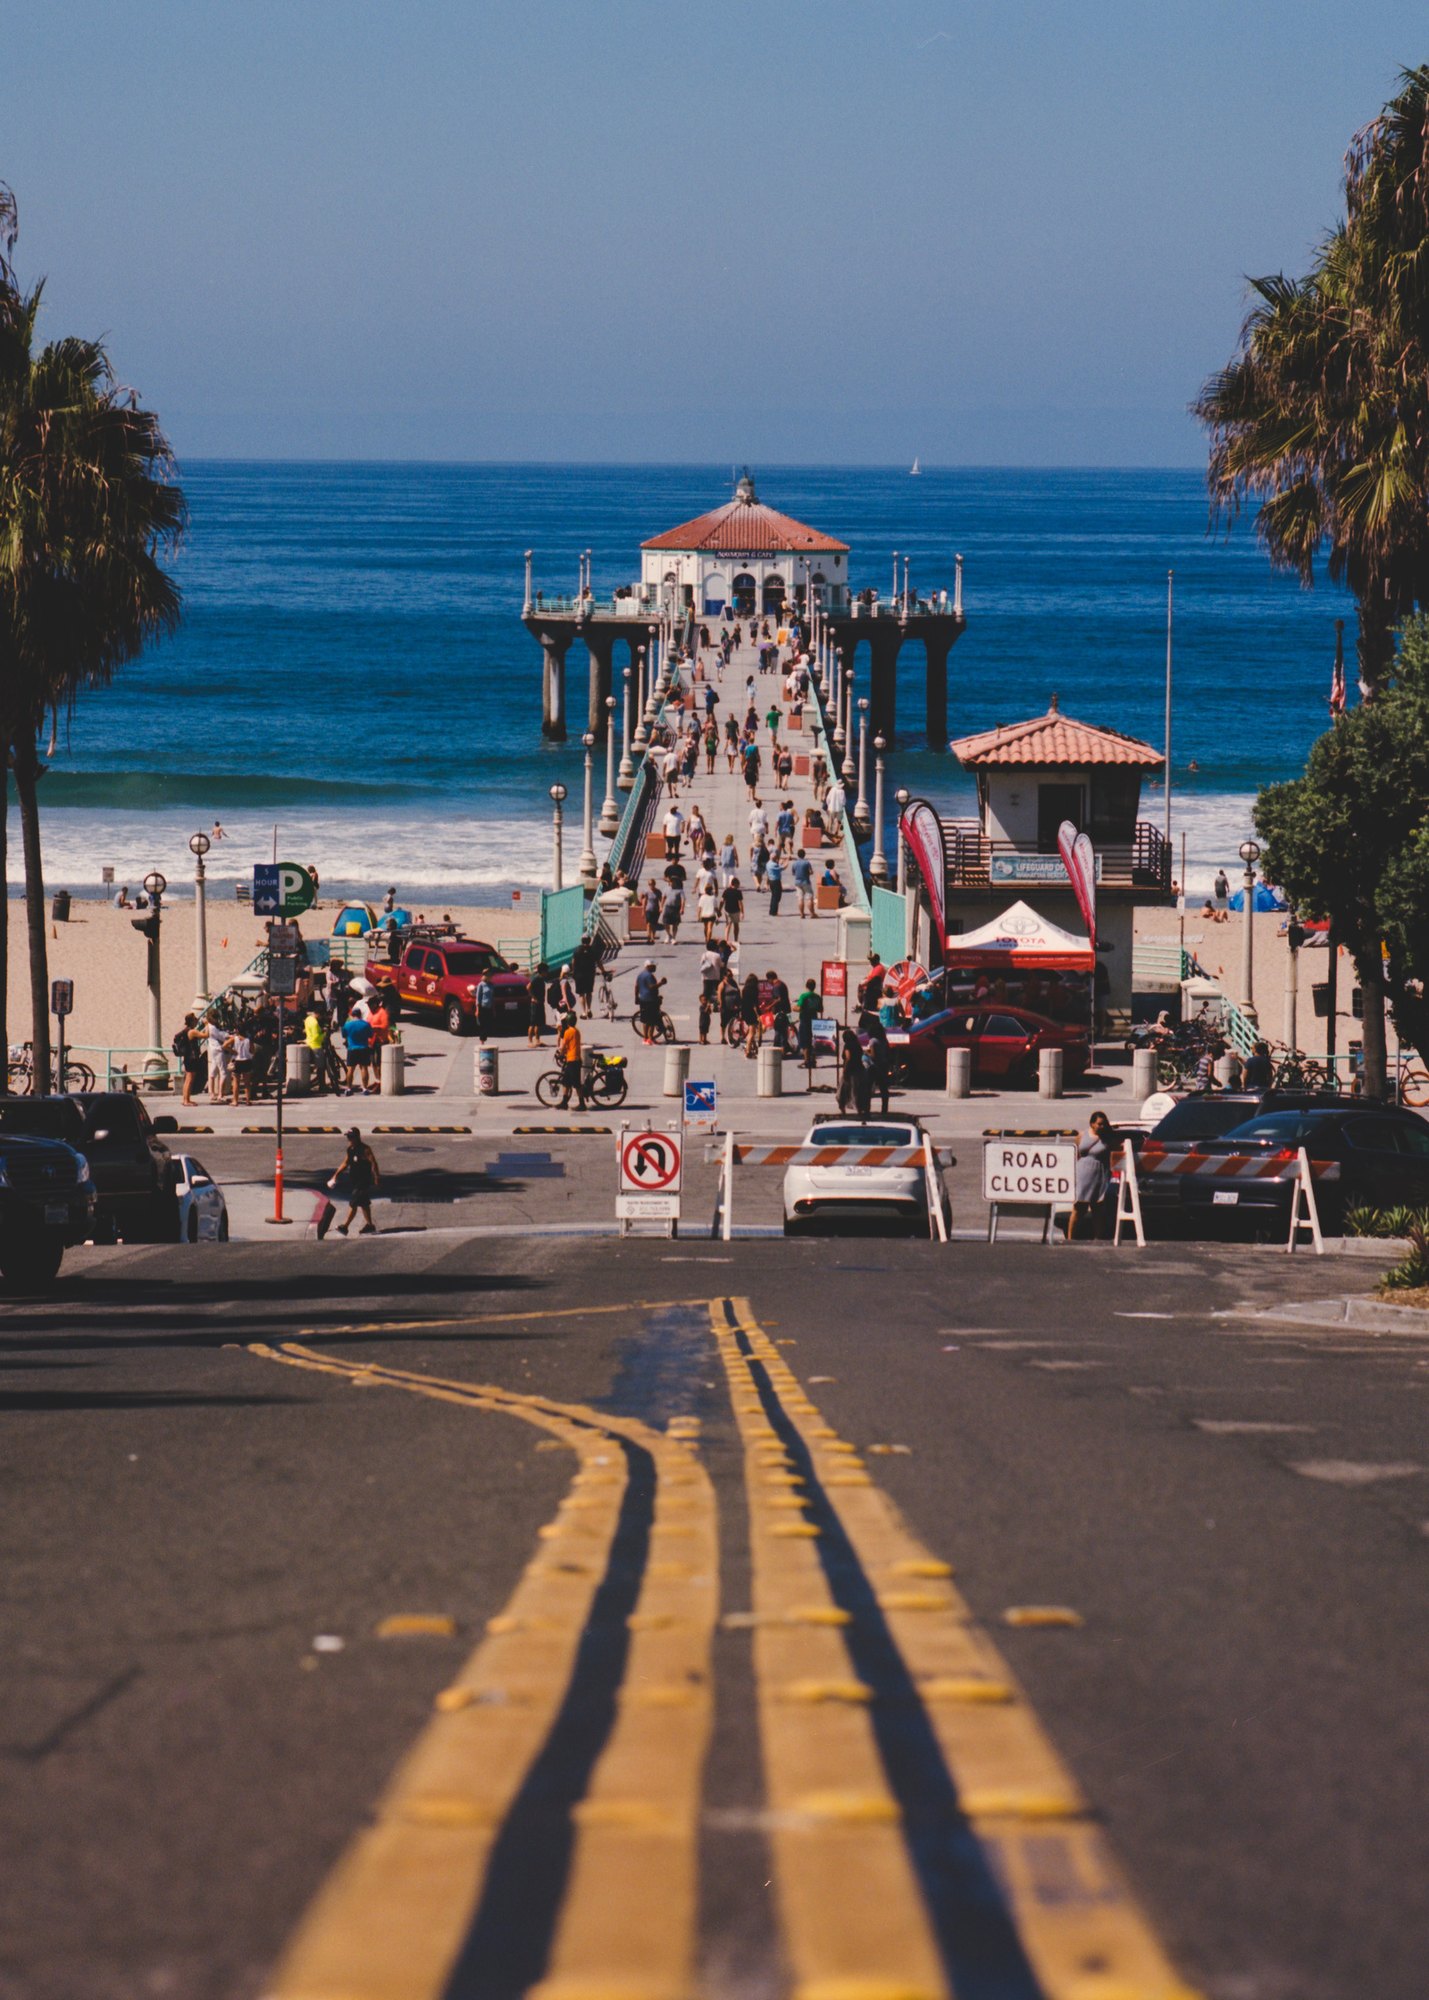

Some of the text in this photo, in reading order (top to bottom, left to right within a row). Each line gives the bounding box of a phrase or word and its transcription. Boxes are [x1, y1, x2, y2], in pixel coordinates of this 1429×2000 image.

[1016, 863, 1054, 871] LIFEGUARD
[279, 870, 303, 906] P
[995, 936, 1046, 944] TOYOTA
[1003, 1151, 1058, 1169] ROAD
[991, 1175, 1069, 1194] CLOSED
